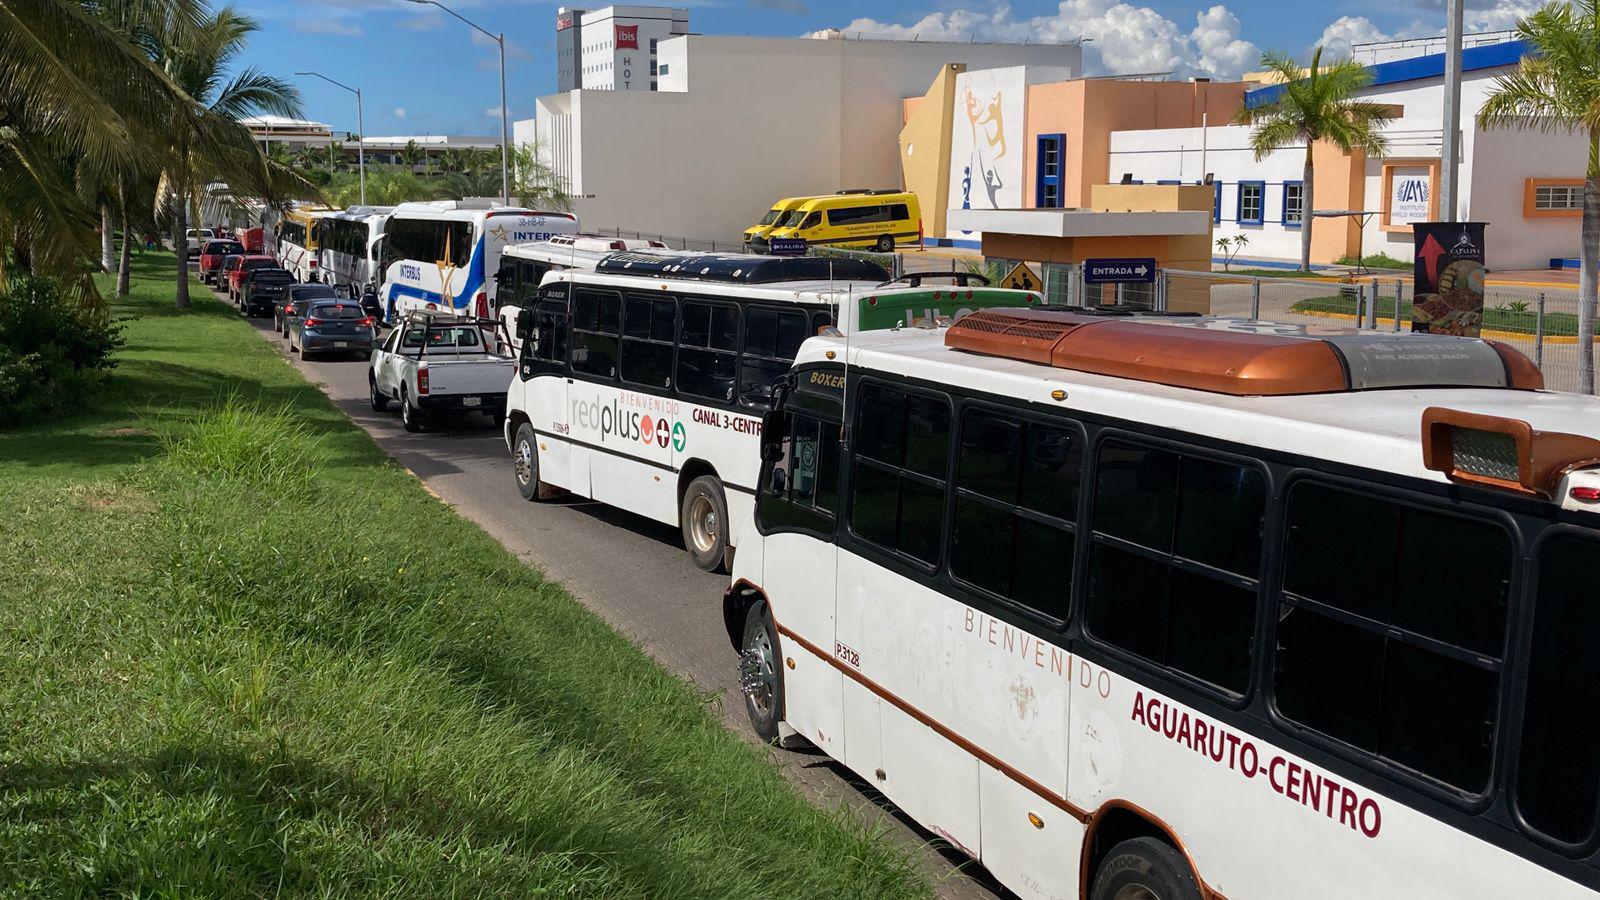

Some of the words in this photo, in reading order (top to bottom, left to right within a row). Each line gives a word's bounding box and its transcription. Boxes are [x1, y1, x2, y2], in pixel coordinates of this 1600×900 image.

[618, 31, 636, 42] ibis
[623, 57, 632, 90] HOT
[518, 217, 546, 227] 38-HB-6F
[1450, 248, 1481, 256] CATALINA
[400, 264, 421, 282] INTERBUS
[1092, 267, 1133, 275] ENTRADA
[810, 371, 846, 389] BOXER
[620, 390, 680, 416] BIENVENIDO
[572, 394, 639, 442] redplus
[692, 407, 722, 428] CANAL
[723, 414, 763, 437] 3-CENTR
[836, 643, 860, 668] P.3128
[964, 607, 1111, 699] BIENVENIDO
[1131, 690, 1382, 839] AGUARUTO-CENTRO
